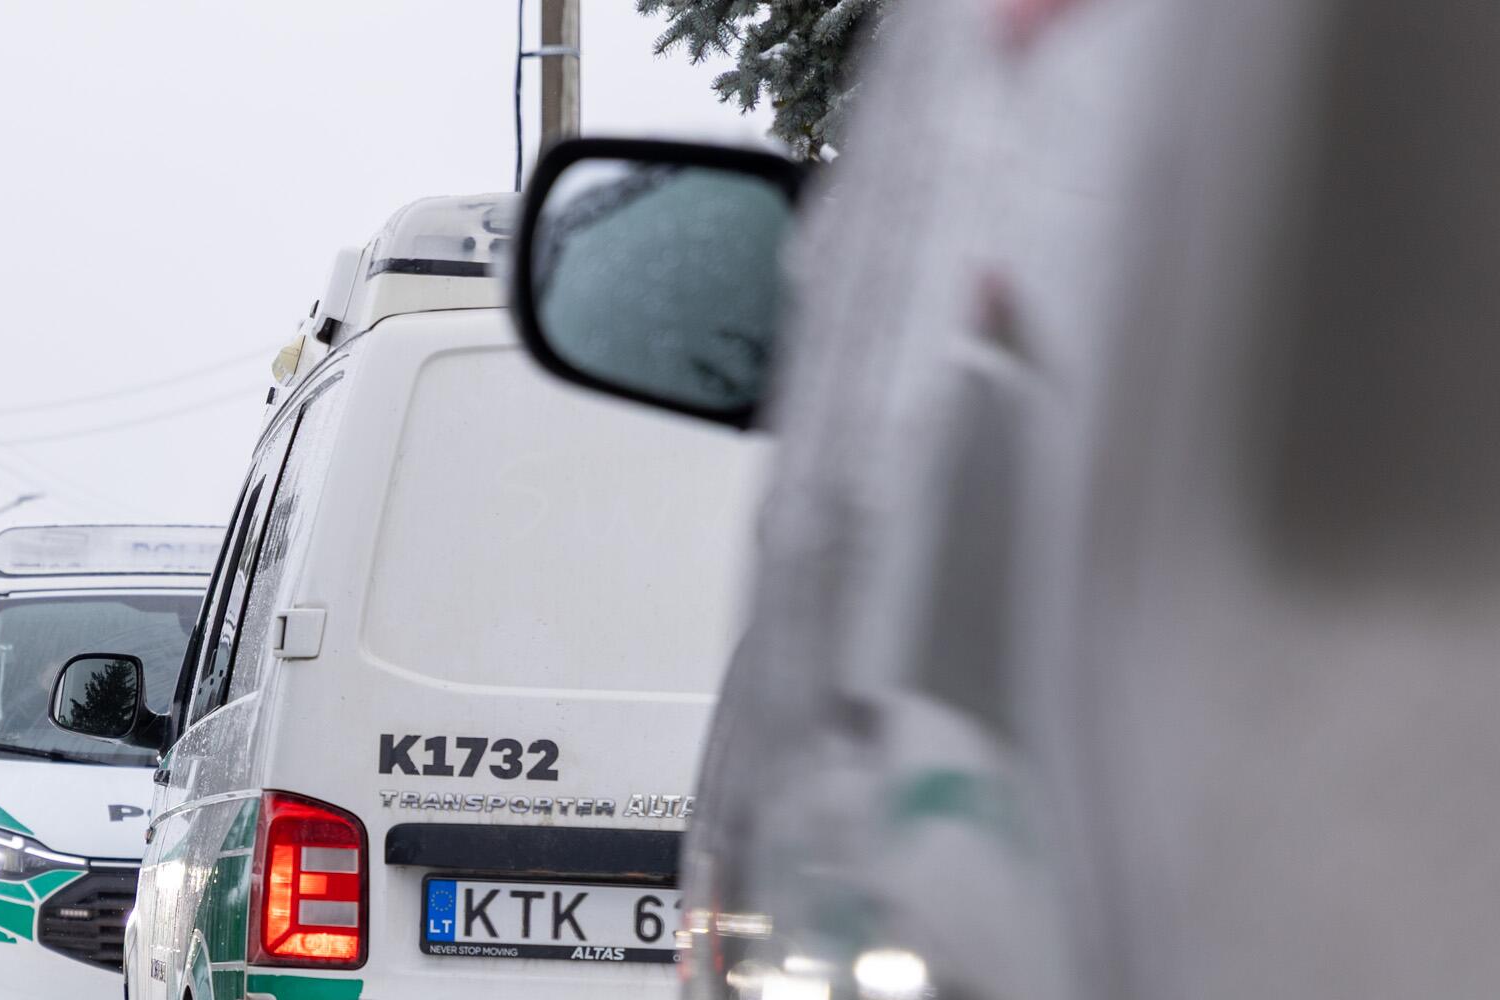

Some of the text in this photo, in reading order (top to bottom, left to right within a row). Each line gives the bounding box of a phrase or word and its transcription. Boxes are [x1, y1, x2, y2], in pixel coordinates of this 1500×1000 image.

[378, 733, 560, 782] K1732
[108, 804, 151, 822] P
[379, 790, 617, 818] TRANSPORTER
[462, 887, 683, 943] KTK 6
[429, 919, 453, 934] LT
[429, 944, 519, 957] NEVER STOP MOVING
[571, 946, 625, 961] ALTAS
